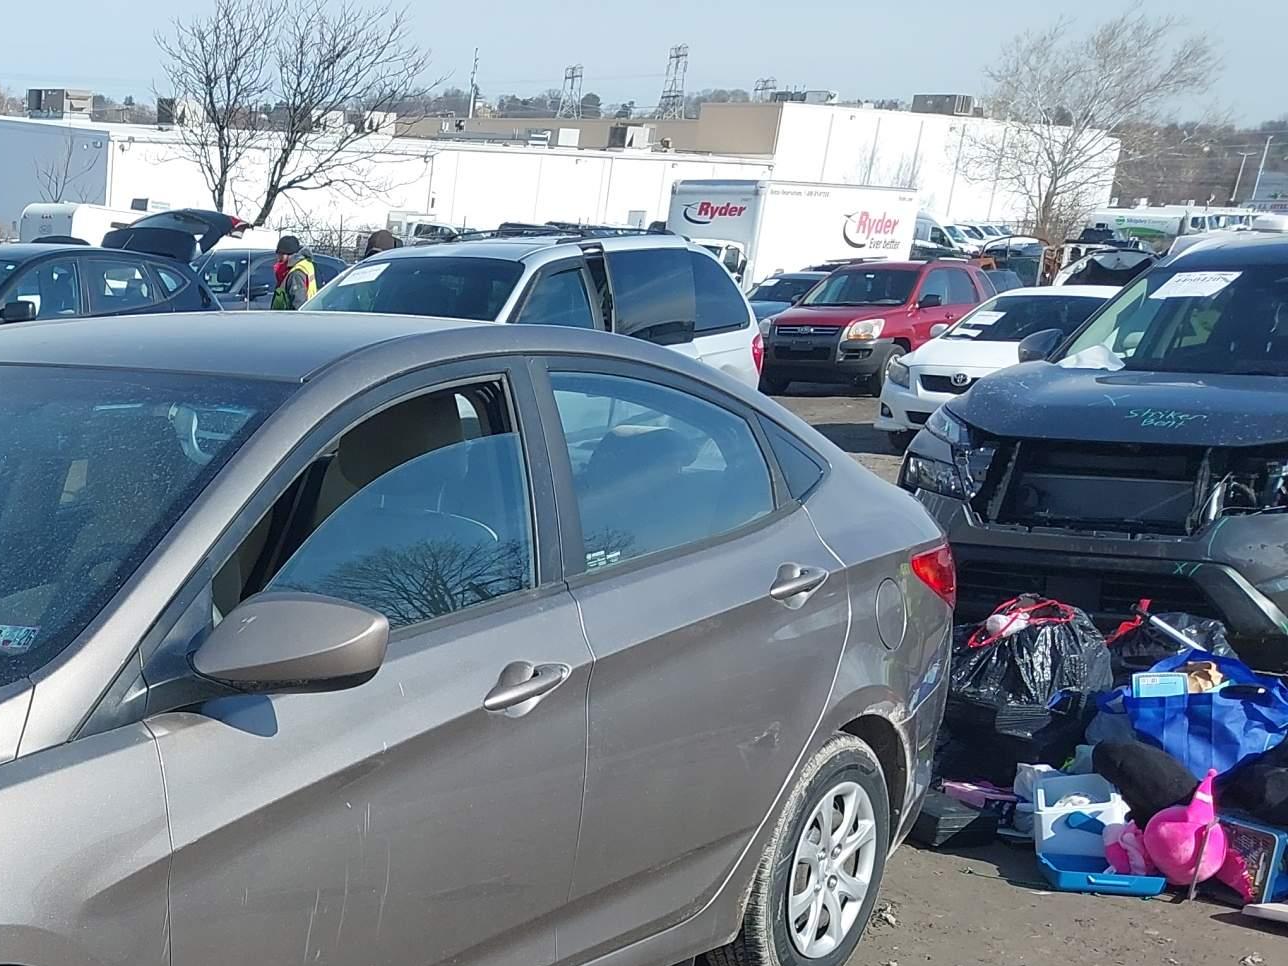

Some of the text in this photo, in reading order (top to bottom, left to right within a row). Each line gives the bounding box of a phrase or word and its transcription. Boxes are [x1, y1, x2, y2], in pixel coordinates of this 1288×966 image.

[697, 202, 746, 219] Ryder
[856, 211, 899, 240] Ryder
[868, 238, 901, 249] Ever better
